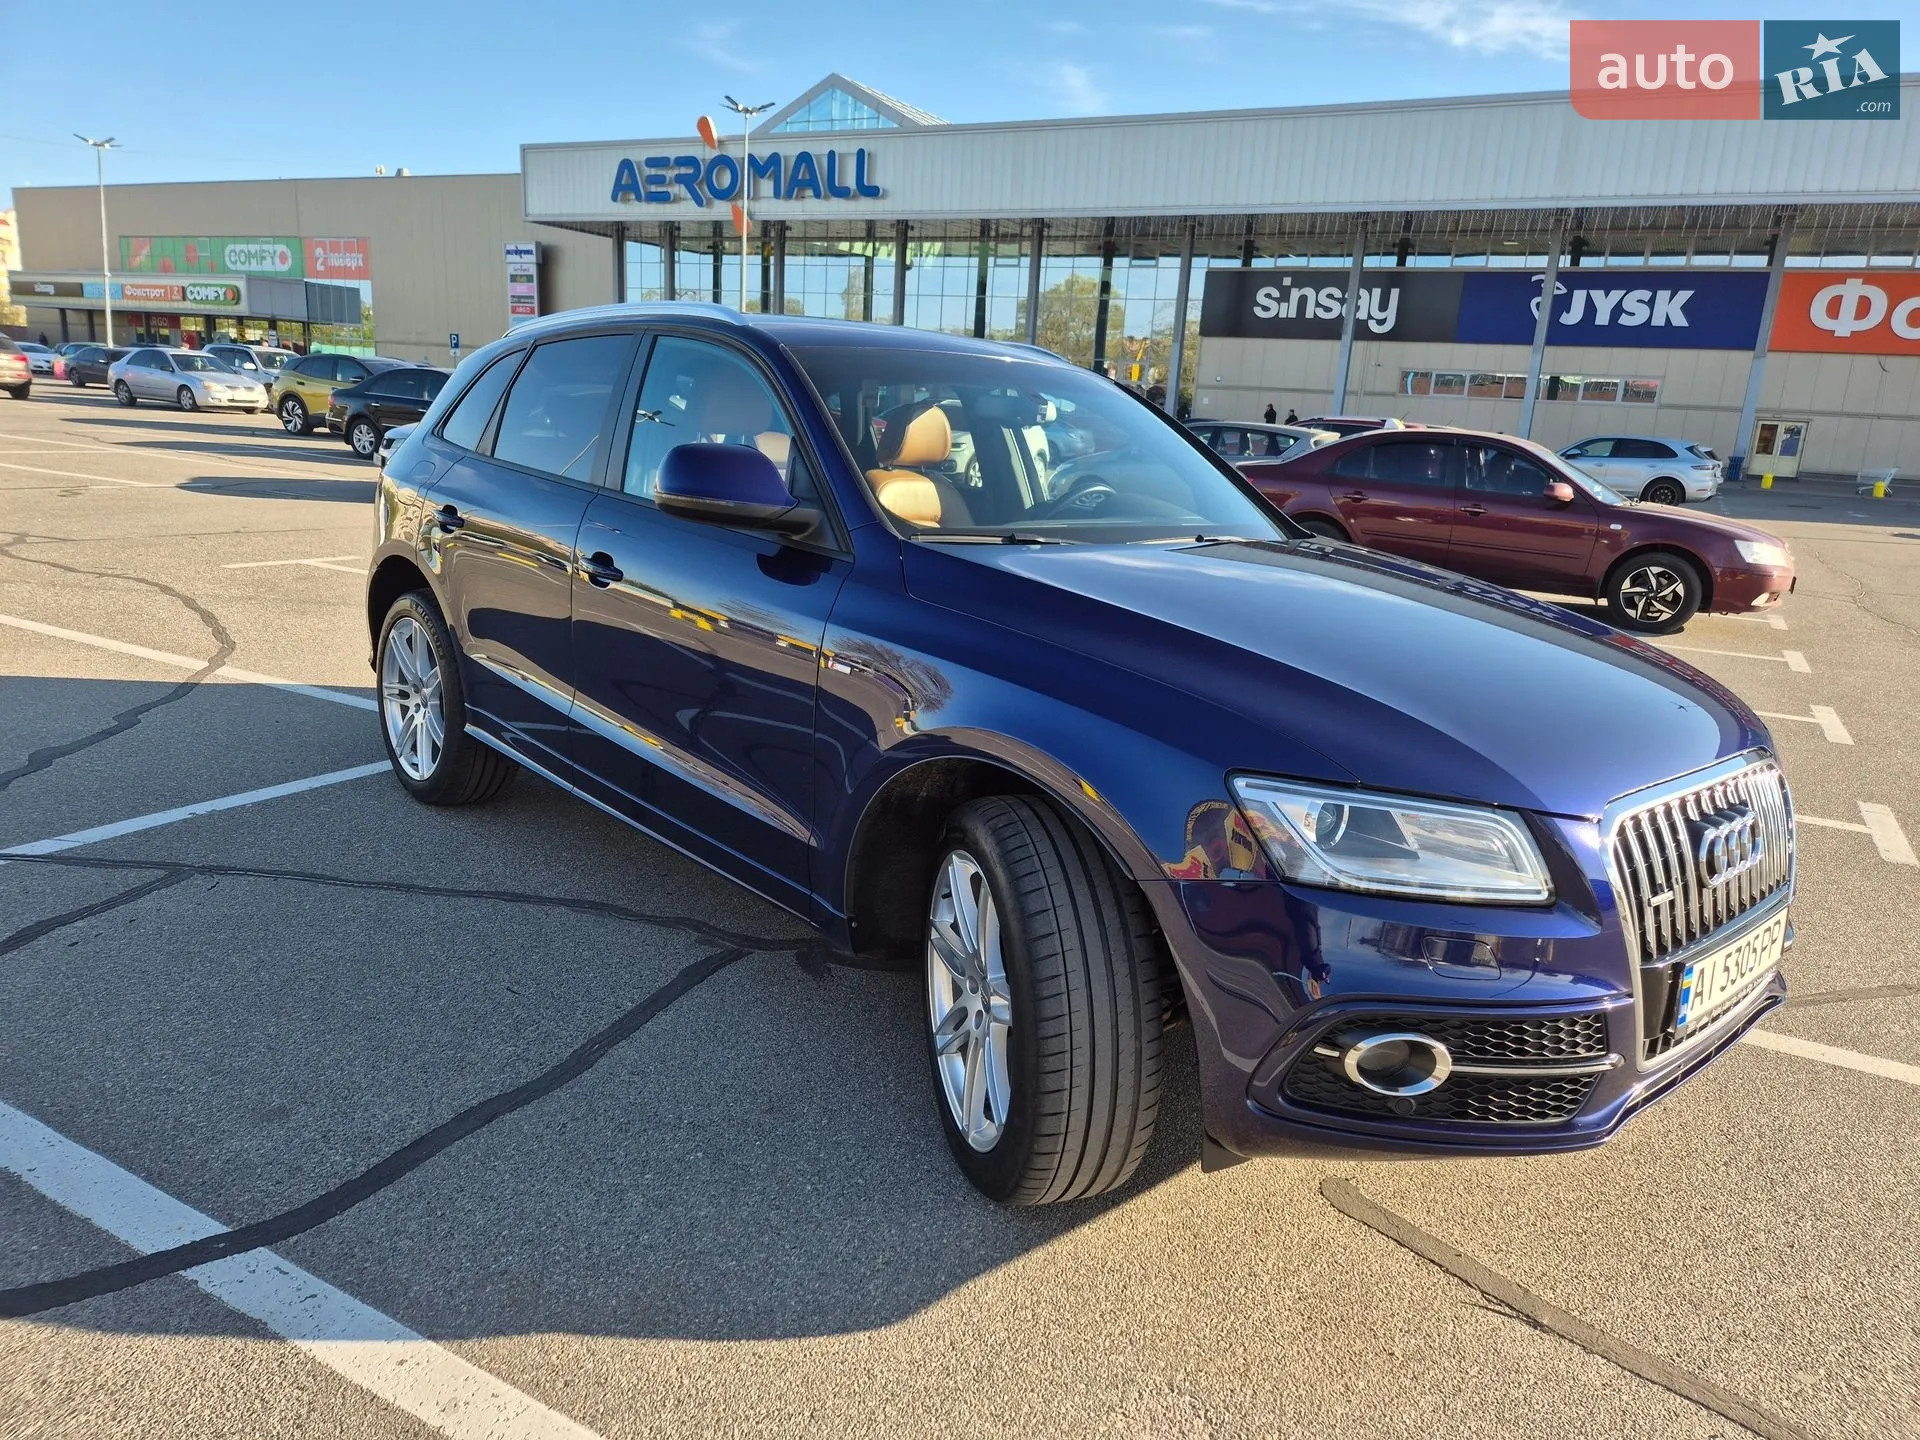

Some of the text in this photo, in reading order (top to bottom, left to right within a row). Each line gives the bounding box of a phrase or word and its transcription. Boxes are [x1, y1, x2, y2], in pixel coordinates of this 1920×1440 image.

[611, 148, 880, 208] AEROMALL
[228, 248, 277, 266] COMFY
[125, 285, 165, 298] Фокстрот
[186, 286, 226, 301] COMFY
[1253, 276, 1400, 334] sinsay
[1558, 289, 1695, 328] JYSK
[1690, 960, 1716, 1011] AI
